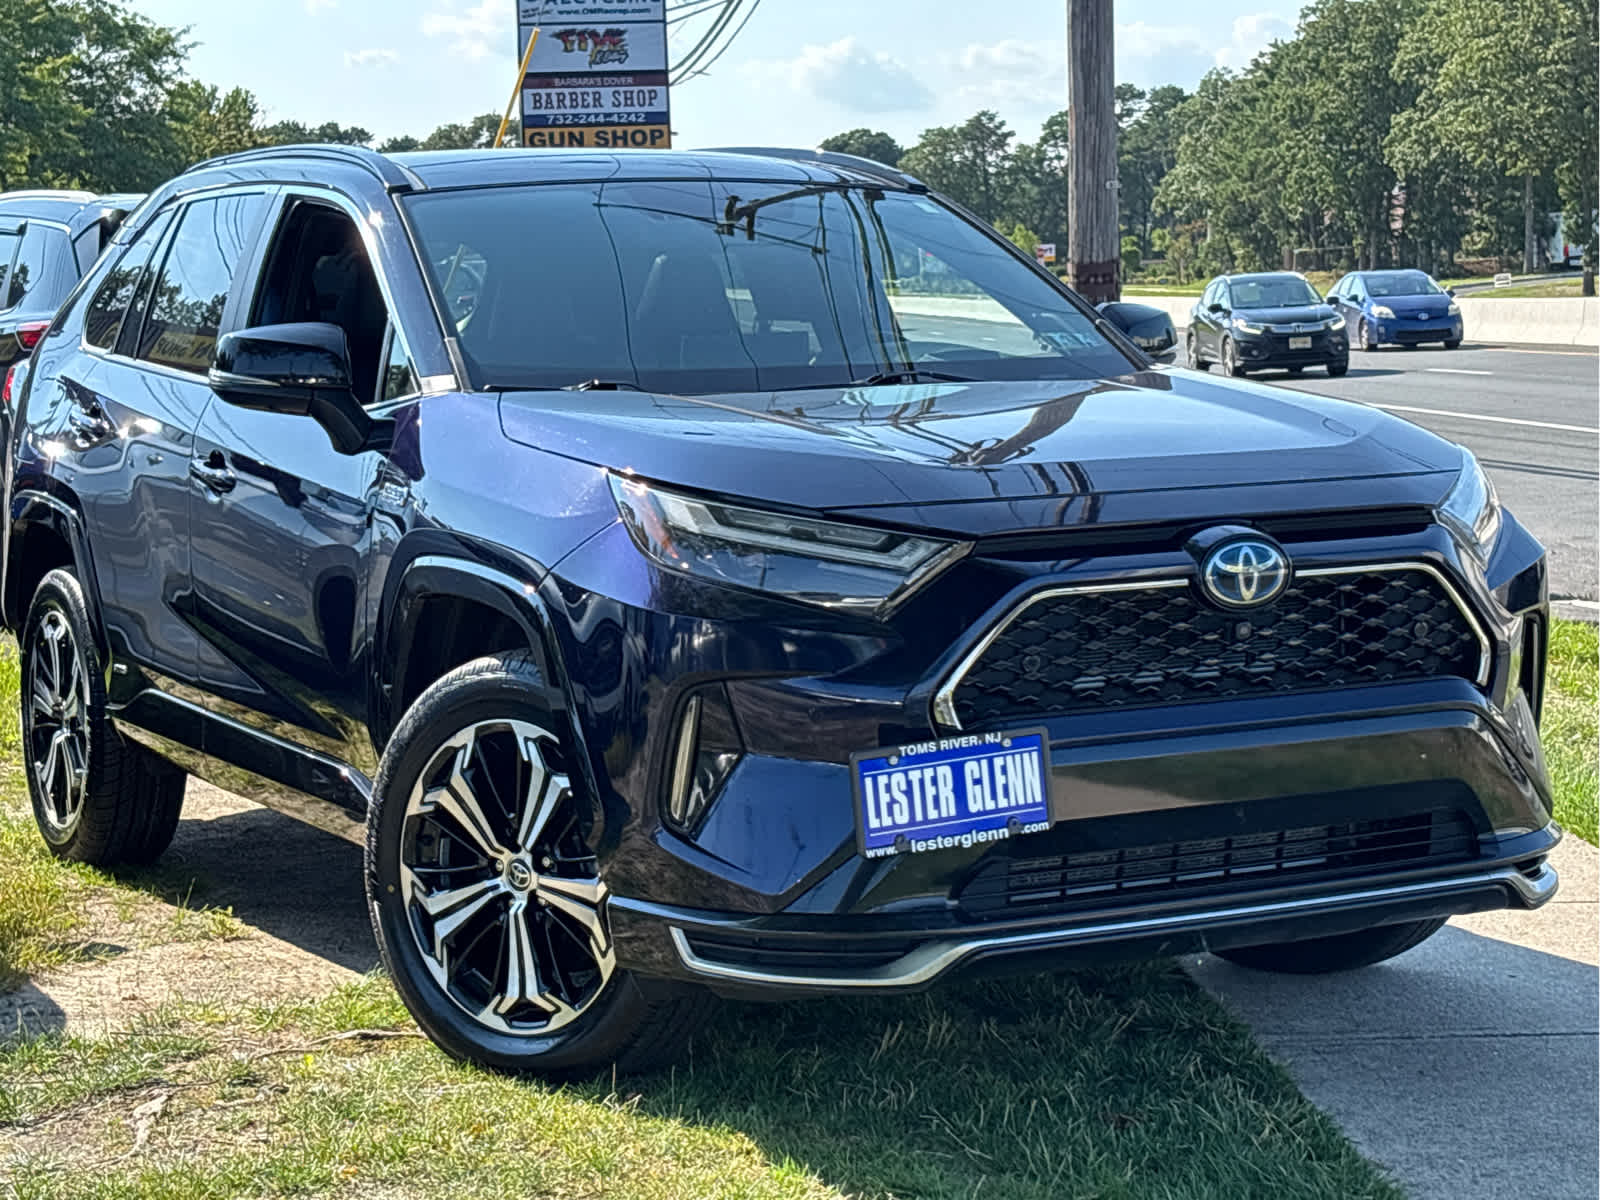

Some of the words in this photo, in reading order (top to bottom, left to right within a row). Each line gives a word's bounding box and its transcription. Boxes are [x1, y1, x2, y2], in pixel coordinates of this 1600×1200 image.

[603, 77, 633, 86] DOVER
[531, 91, 604, 110] BARBER
[611, 89, 658, 108] SHOP
[546, 113, 646, 125] 732-244-4242
[528, 131, 585, 147] GUN
[594, 129, 665, 147] SHOP
[899, 742, 936, 757] TOMS
[985, 732, 1002, 744] NJ
[864, 765, 957, 829] LESTER
[963, 751, 1042, 813] GLENN
[911, 827, 1009, 853] lesterglenn
